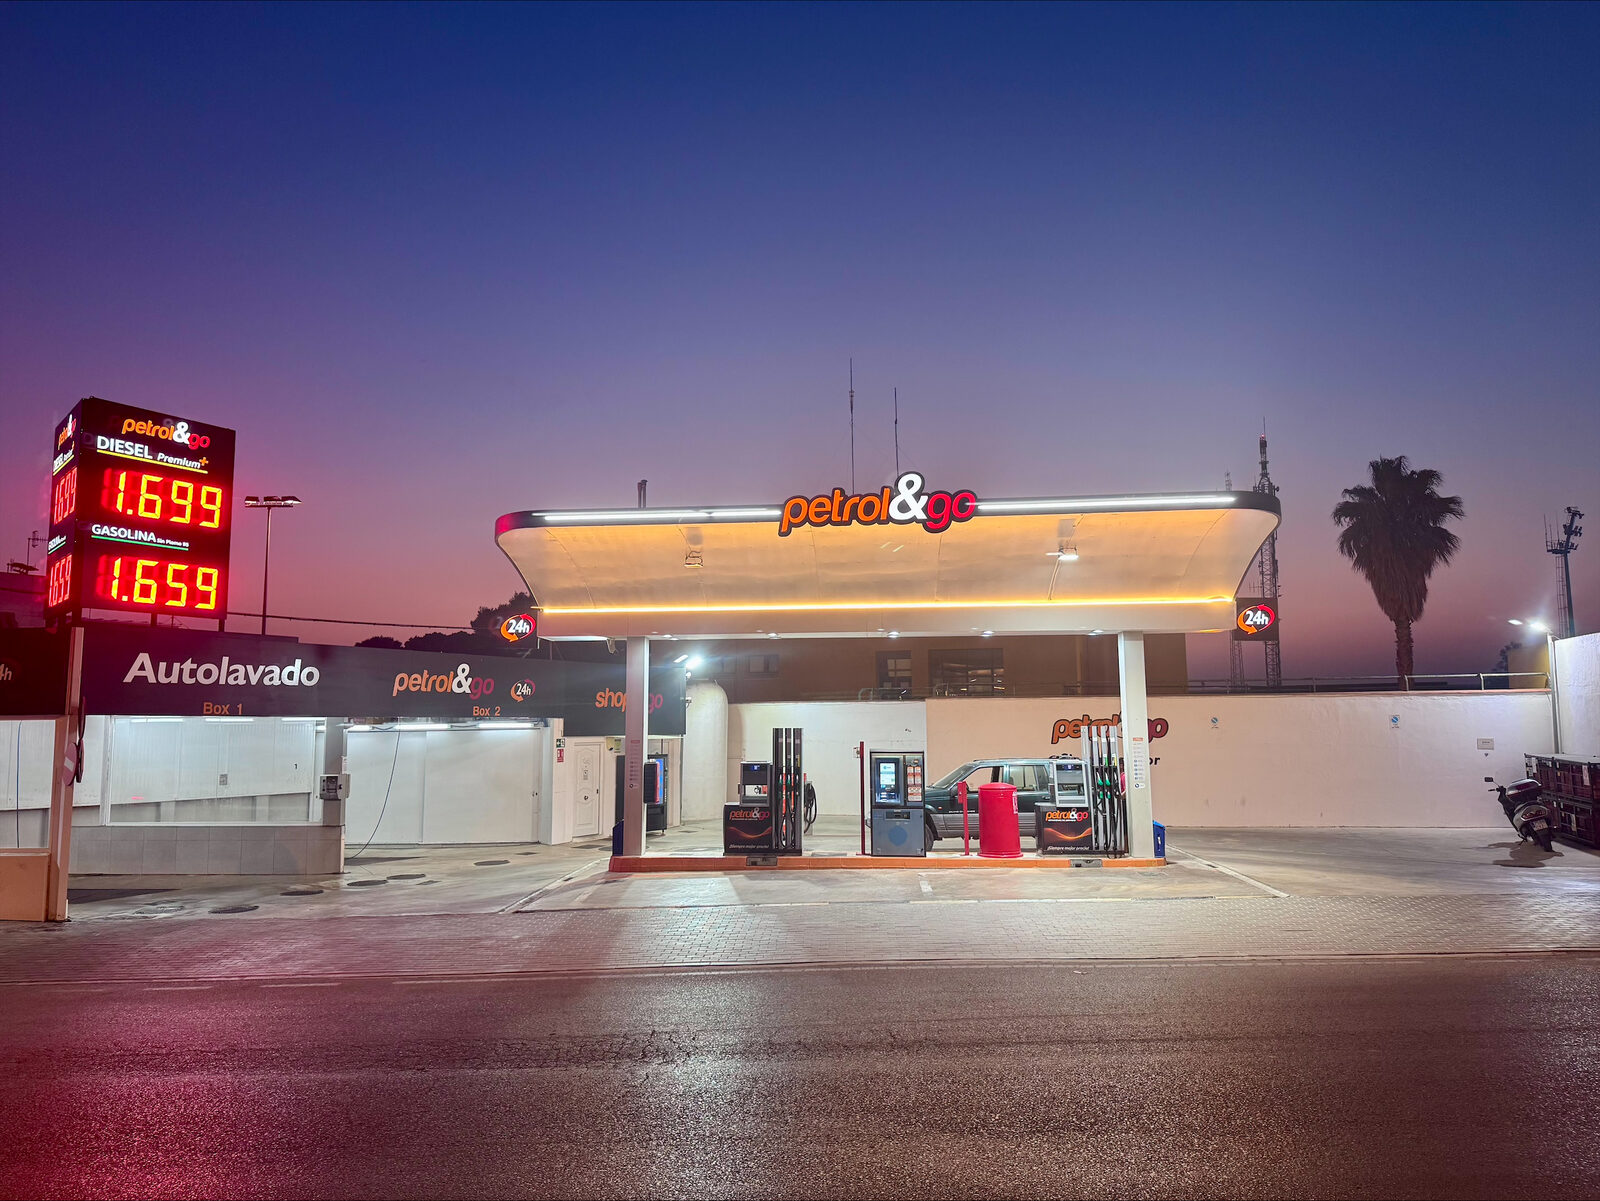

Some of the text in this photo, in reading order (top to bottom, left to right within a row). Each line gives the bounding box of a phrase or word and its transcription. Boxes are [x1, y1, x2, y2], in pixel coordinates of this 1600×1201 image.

[121, 418, 211, 450] petrol&go
[97, 435, 153, 459] DIESEL
[116, 471, 222, 528] 1.699
[779, 471, 977, 534] petrol&go
[92, 524, 156, 543] GASOLINA
[111, 557, 219, 609] 1.659
[507, 618, 530, 634] 24h
[1244, 610, 1269, 625] 24h
[123, 652, 320, 687] Autolavado
[392, 663, 495, 700] petrol&go
[516, 683, 531, 696] 24h
[203, 701, 243, 716] Box 1
[472, 705, 501, 717] Box 2
[1045, 808, 1089, 822] petrol&go
